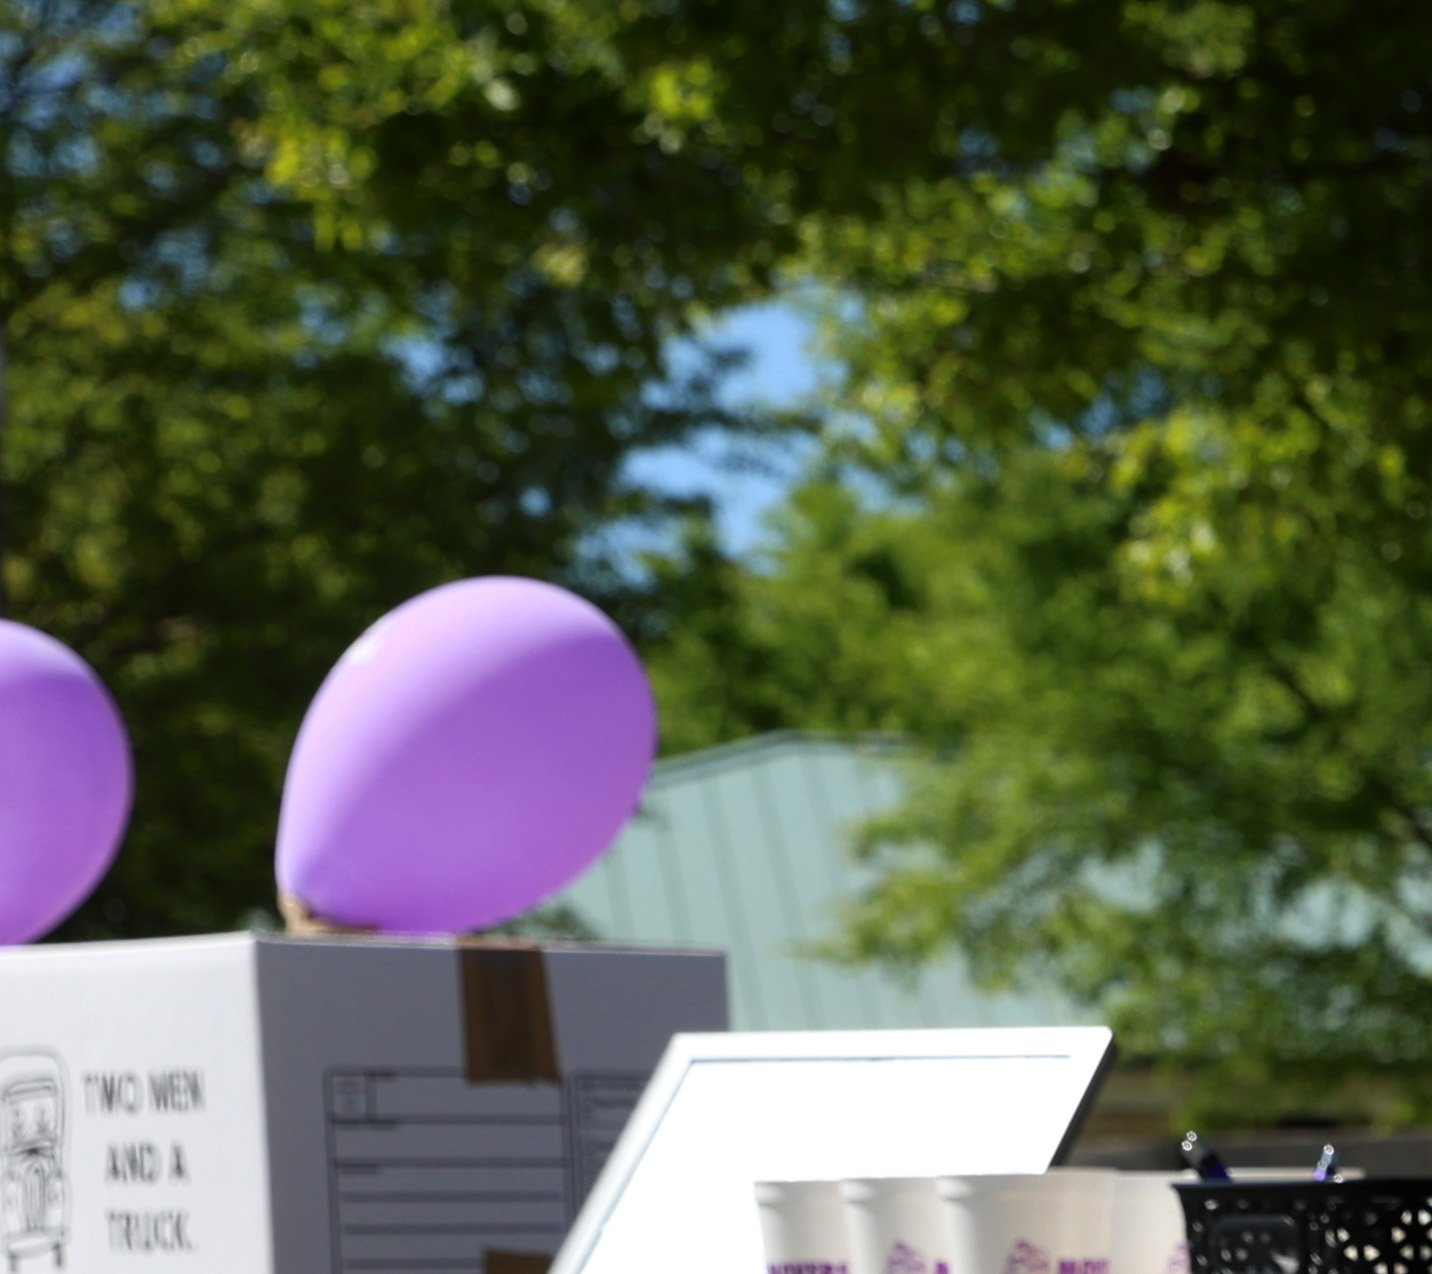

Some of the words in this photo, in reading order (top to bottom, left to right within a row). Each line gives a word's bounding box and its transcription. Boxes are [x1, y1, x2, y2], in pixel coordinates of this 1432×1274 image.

[83, 1072, 146, 1115] TWO
[148, 1070, 205, 1114] MEN
[105, 1141, 163, 1184] AND
[168, 1139, 191, 1184] A
